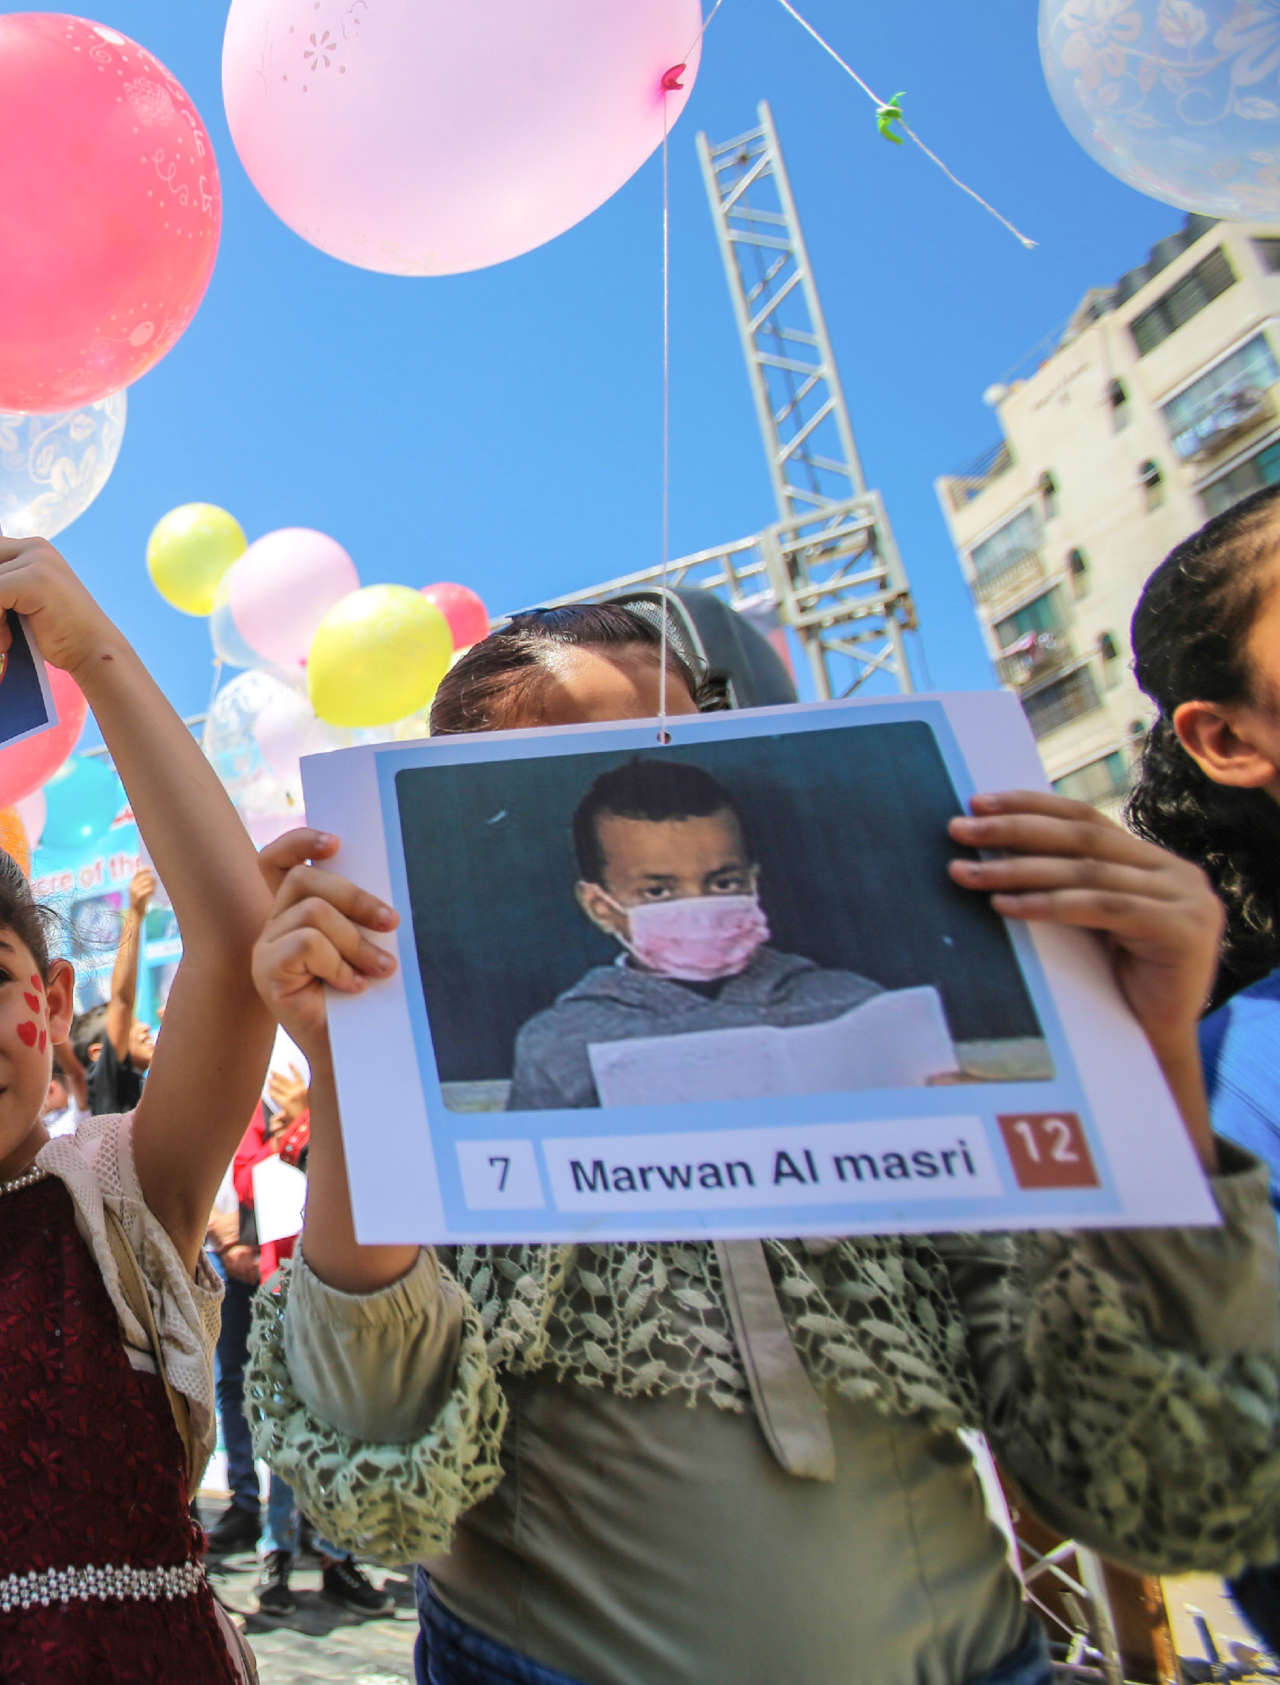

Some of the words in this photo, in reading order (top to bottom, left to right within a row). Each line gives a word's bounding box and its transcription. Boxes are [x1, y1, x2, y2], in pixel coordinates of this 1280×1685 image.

[488, 1155, 512, 1193] 7
[569, 1158, 756, 1193] Marwan
[772, 1149, 821, 1186] Al
[832, 1138, 977, 1183] masri
[1014, 1117, 1081, 1164] 12
